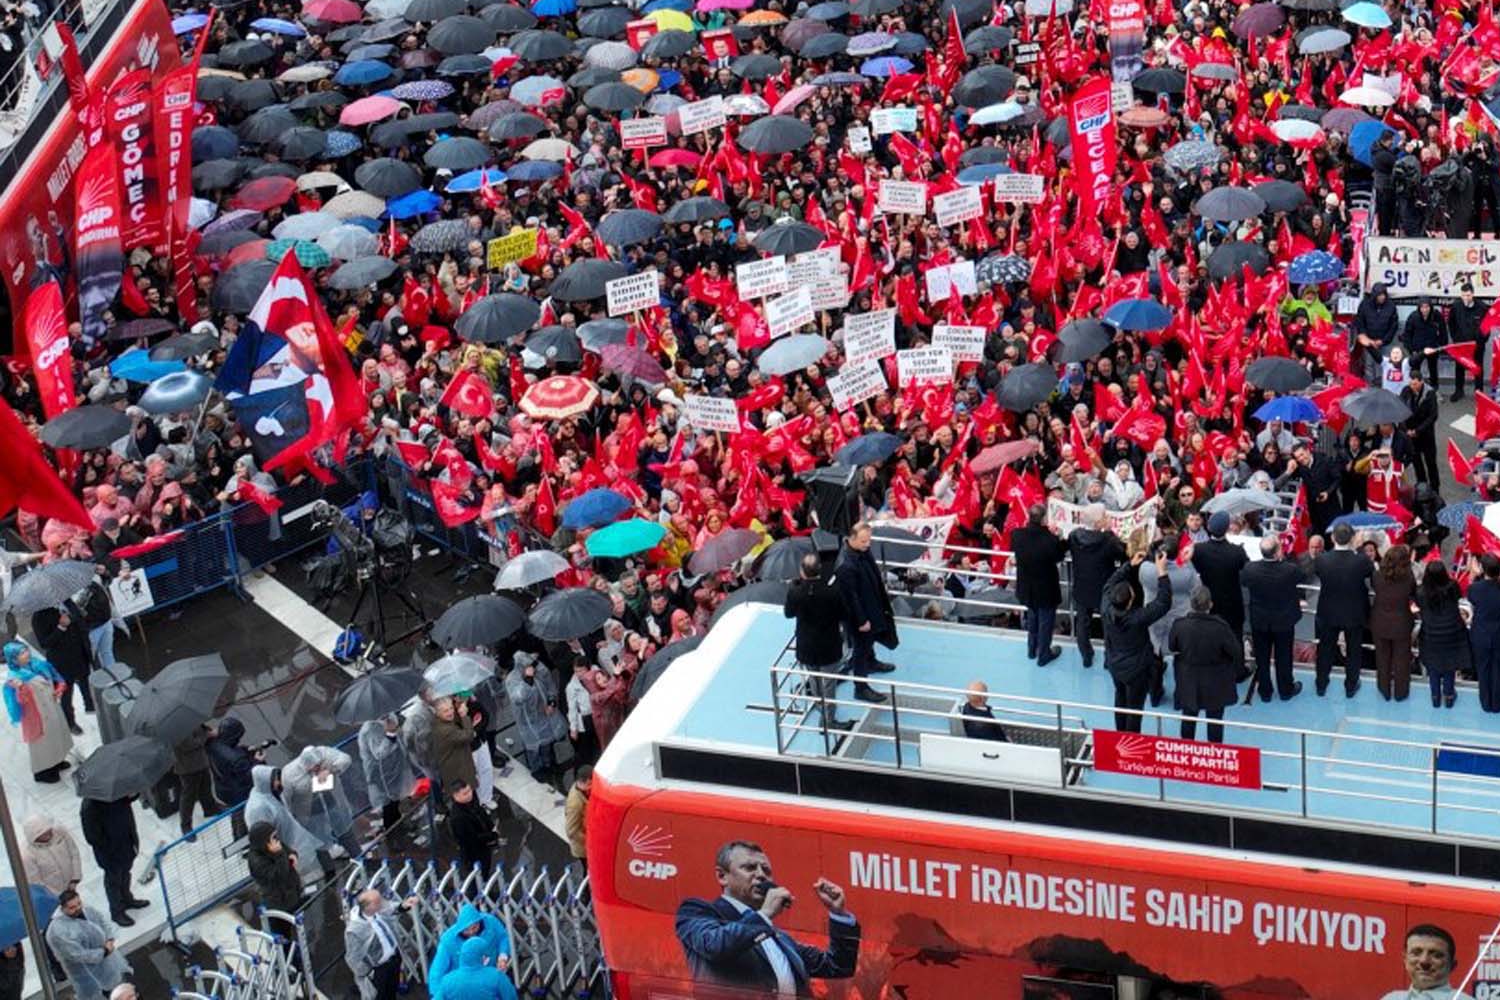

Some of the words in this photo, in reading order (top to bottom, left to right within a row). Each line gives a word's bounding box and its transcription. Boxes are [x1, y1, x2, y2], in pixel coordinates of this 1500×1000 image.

[1110, 3, 1141, 18] CHP
[114, 102, 146, 121] CHP
[1080, 114, 1108, 131] CHP
[121, 123, 146, 223] GÖMEÇ
[78, 206, 113, 232] CHP
[1379, 246, 1431, 264] ALTIN
[612, 273, 652, 288] KADINA
[1384, 270, 1409, 288] SU
[37, 336, 70, 370] CHP
[1155, 740, 1239, 760] CUMHURİYET
[1156, 752, 1189, 765] HALK
[1192, 757, 1240, 771] PARTİSİ
[1117, 760, 1172, 777] Türkiye'nin
[1174, 766, 1204, 780] Birinci
[1207, 770, 1240, 784] Partisi
[628, 859, 678, 880] CHP
[1252, 902, 1387, 954] ÇIKIYOR
